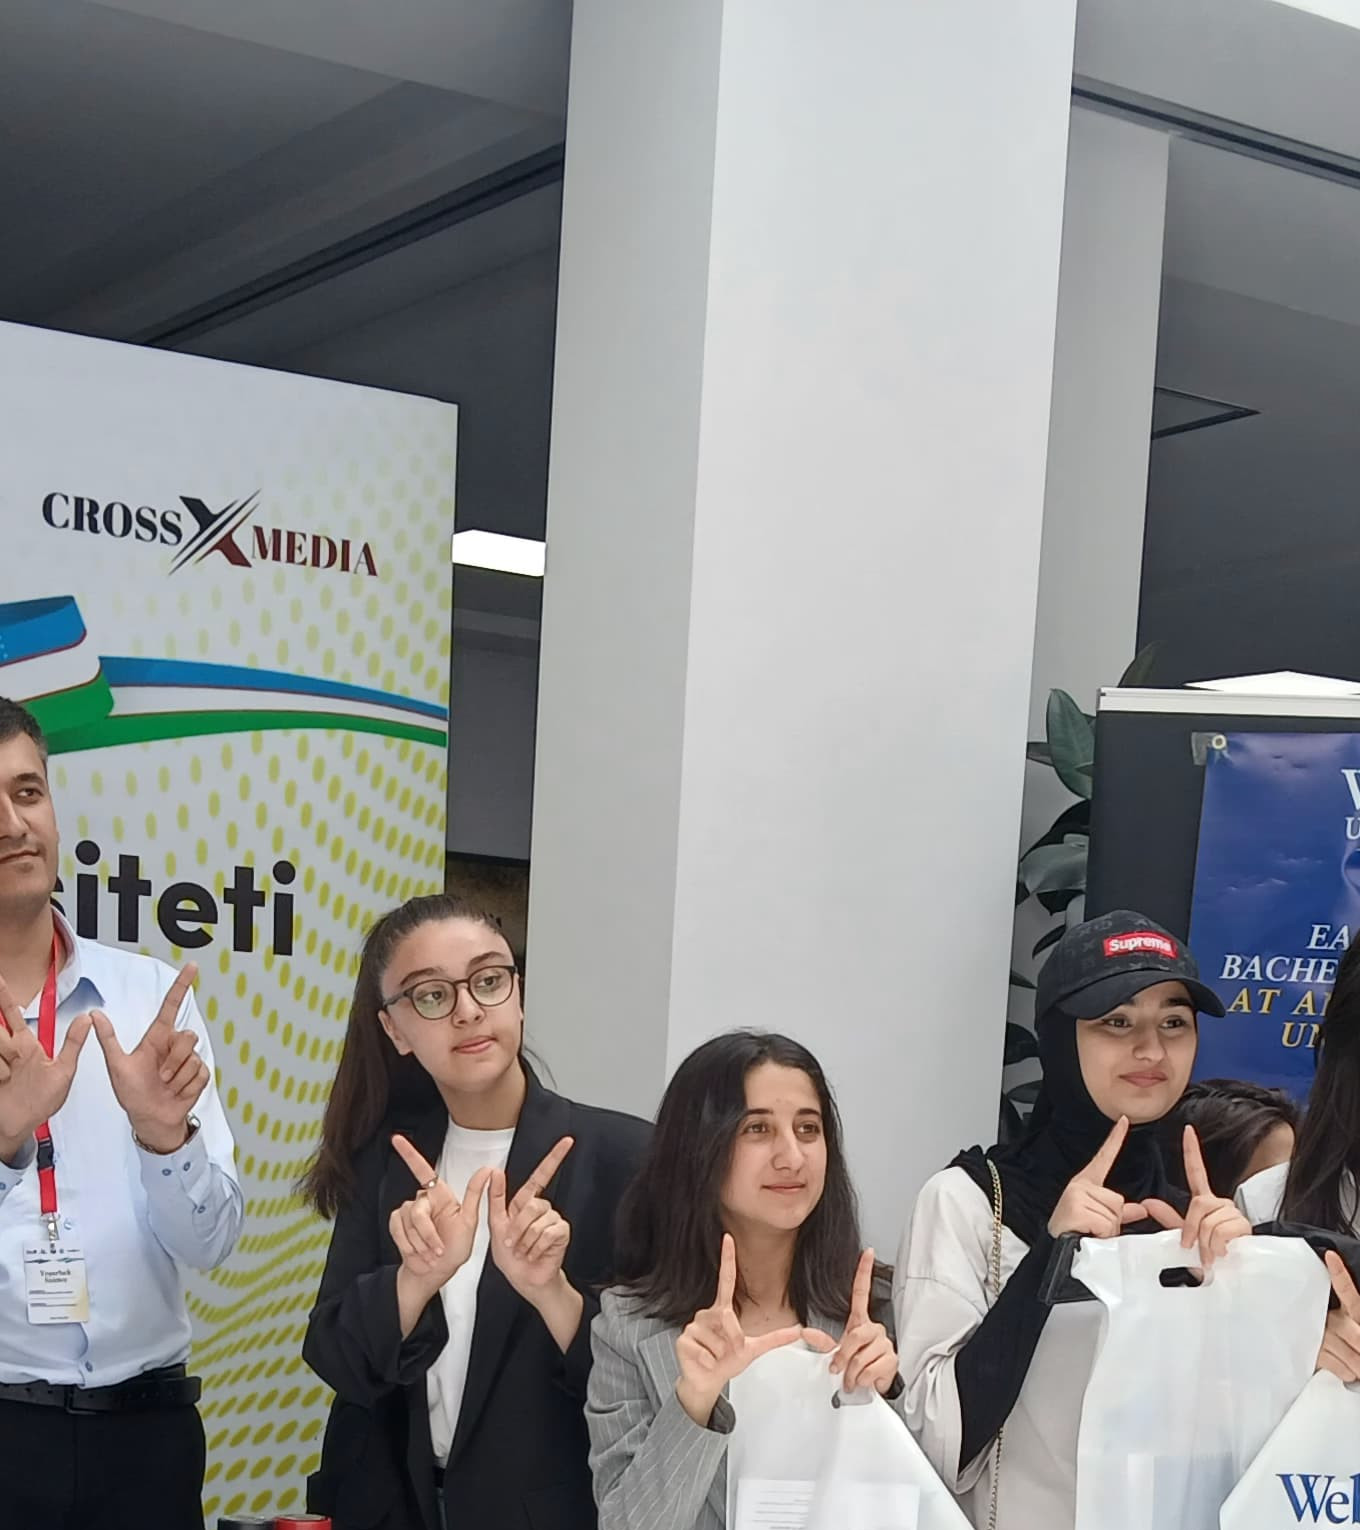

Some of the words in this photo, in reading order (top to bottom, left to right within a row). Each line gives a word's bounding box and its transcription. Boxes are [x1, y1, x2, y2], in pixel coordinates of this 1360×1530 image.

[42, 491, 183, 546] CROSS
[251, 525, 379, 577] MEDIA
[1305, 923, 1351, 951] EA
[1218, 954, 1340, 985] BACHE
[1226, 987, 1282, 1014] AT
